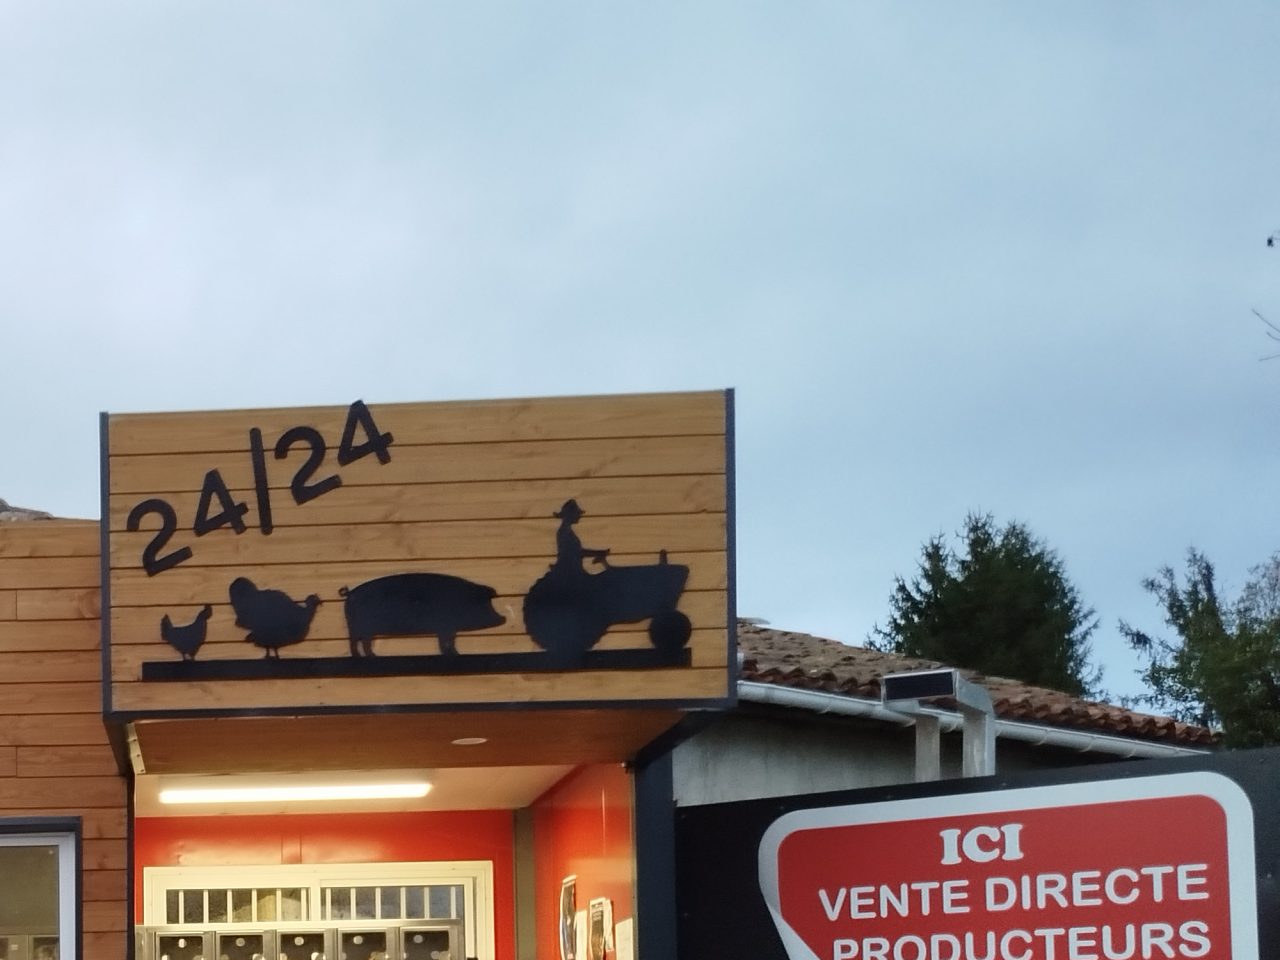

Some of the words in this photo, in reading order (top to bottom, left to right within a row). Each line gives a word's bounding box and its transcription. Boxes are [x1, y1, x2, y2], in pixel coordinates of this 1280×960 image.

[939, 823, 1024, 866] ICI
[818, 879, 971, 922] VENTE
[985, 863, 1210, 913] DIRECTE
